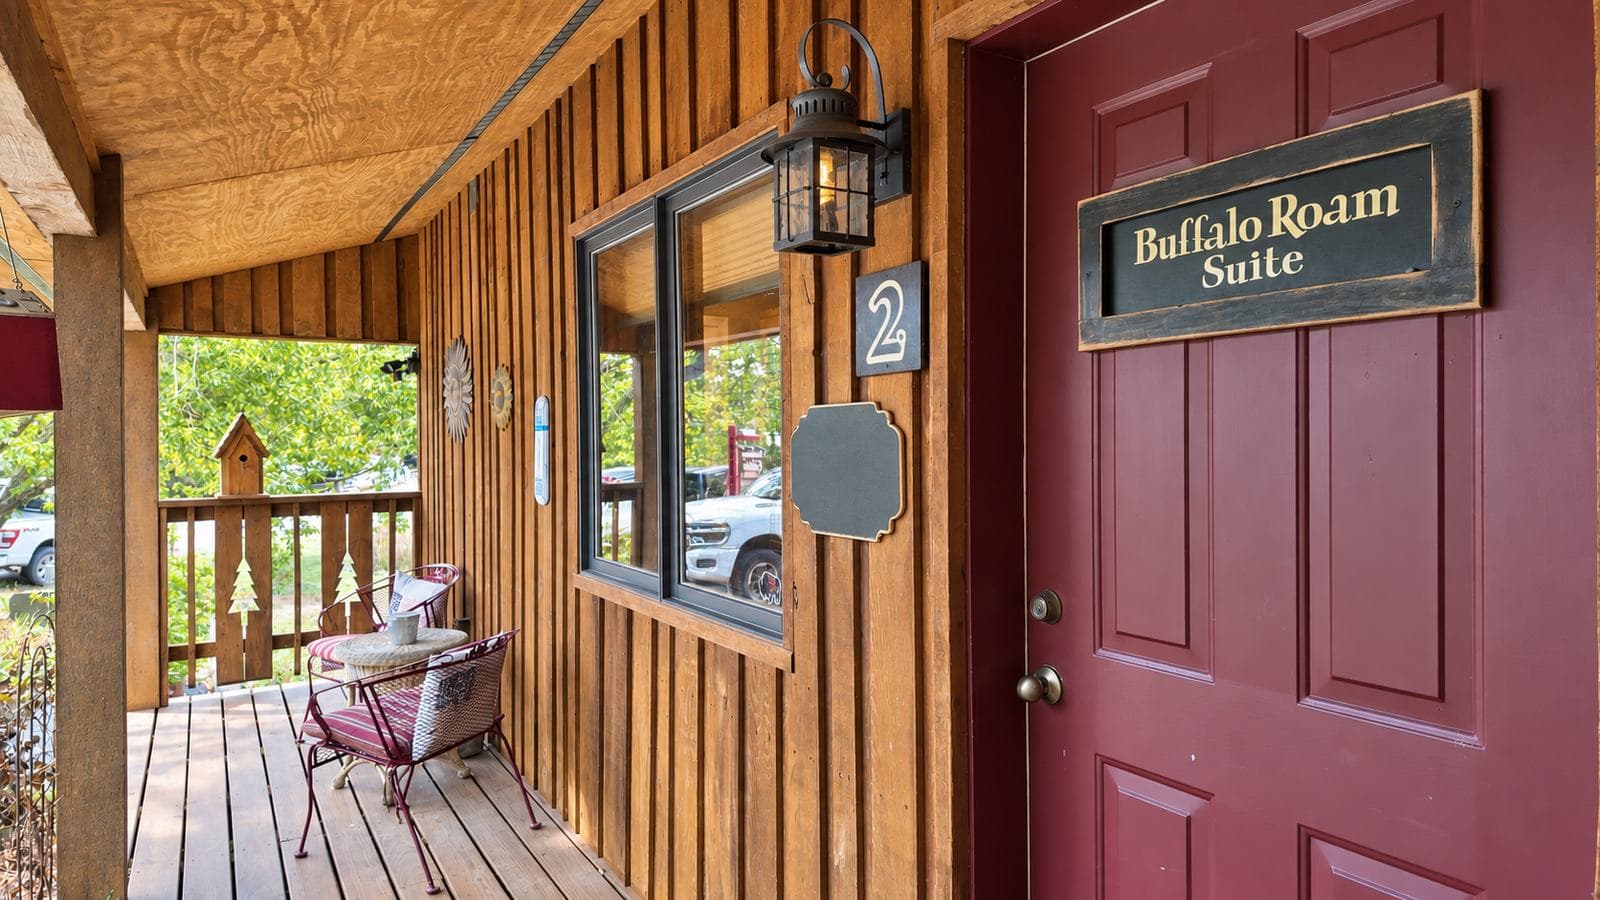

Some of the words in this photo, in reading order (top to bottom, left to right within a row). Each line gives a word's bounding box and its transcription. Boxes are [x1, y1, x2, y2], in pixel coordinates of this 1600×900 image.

[1133, 206, 1263, 265] Buffalo
[1267, 184, 1401, 239] Roam
[1202, 247, 1304, 289] Suite
[866, 279, 906, 365] 2
